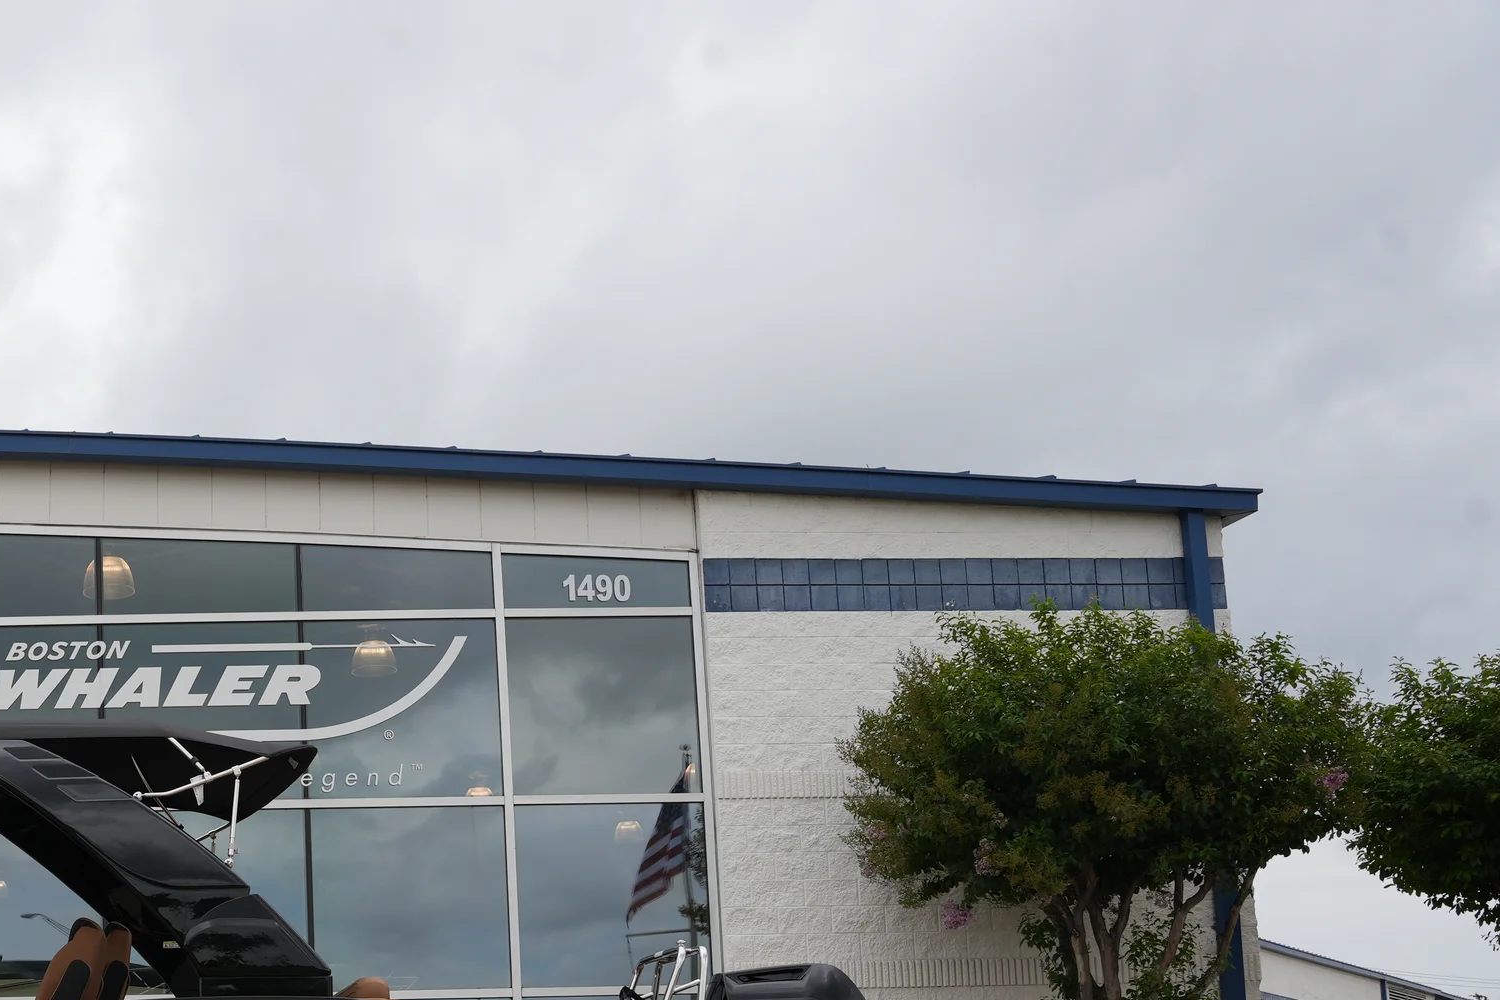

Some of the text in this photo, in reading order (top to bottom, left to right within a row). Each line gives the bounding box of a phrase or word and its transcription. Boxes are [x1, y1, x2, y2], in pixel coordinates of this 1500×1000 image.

[562, 574, 631, 602] 1490
[5, 640, 131, 662] BOSTON
[299, 763, 404, 793] egend
